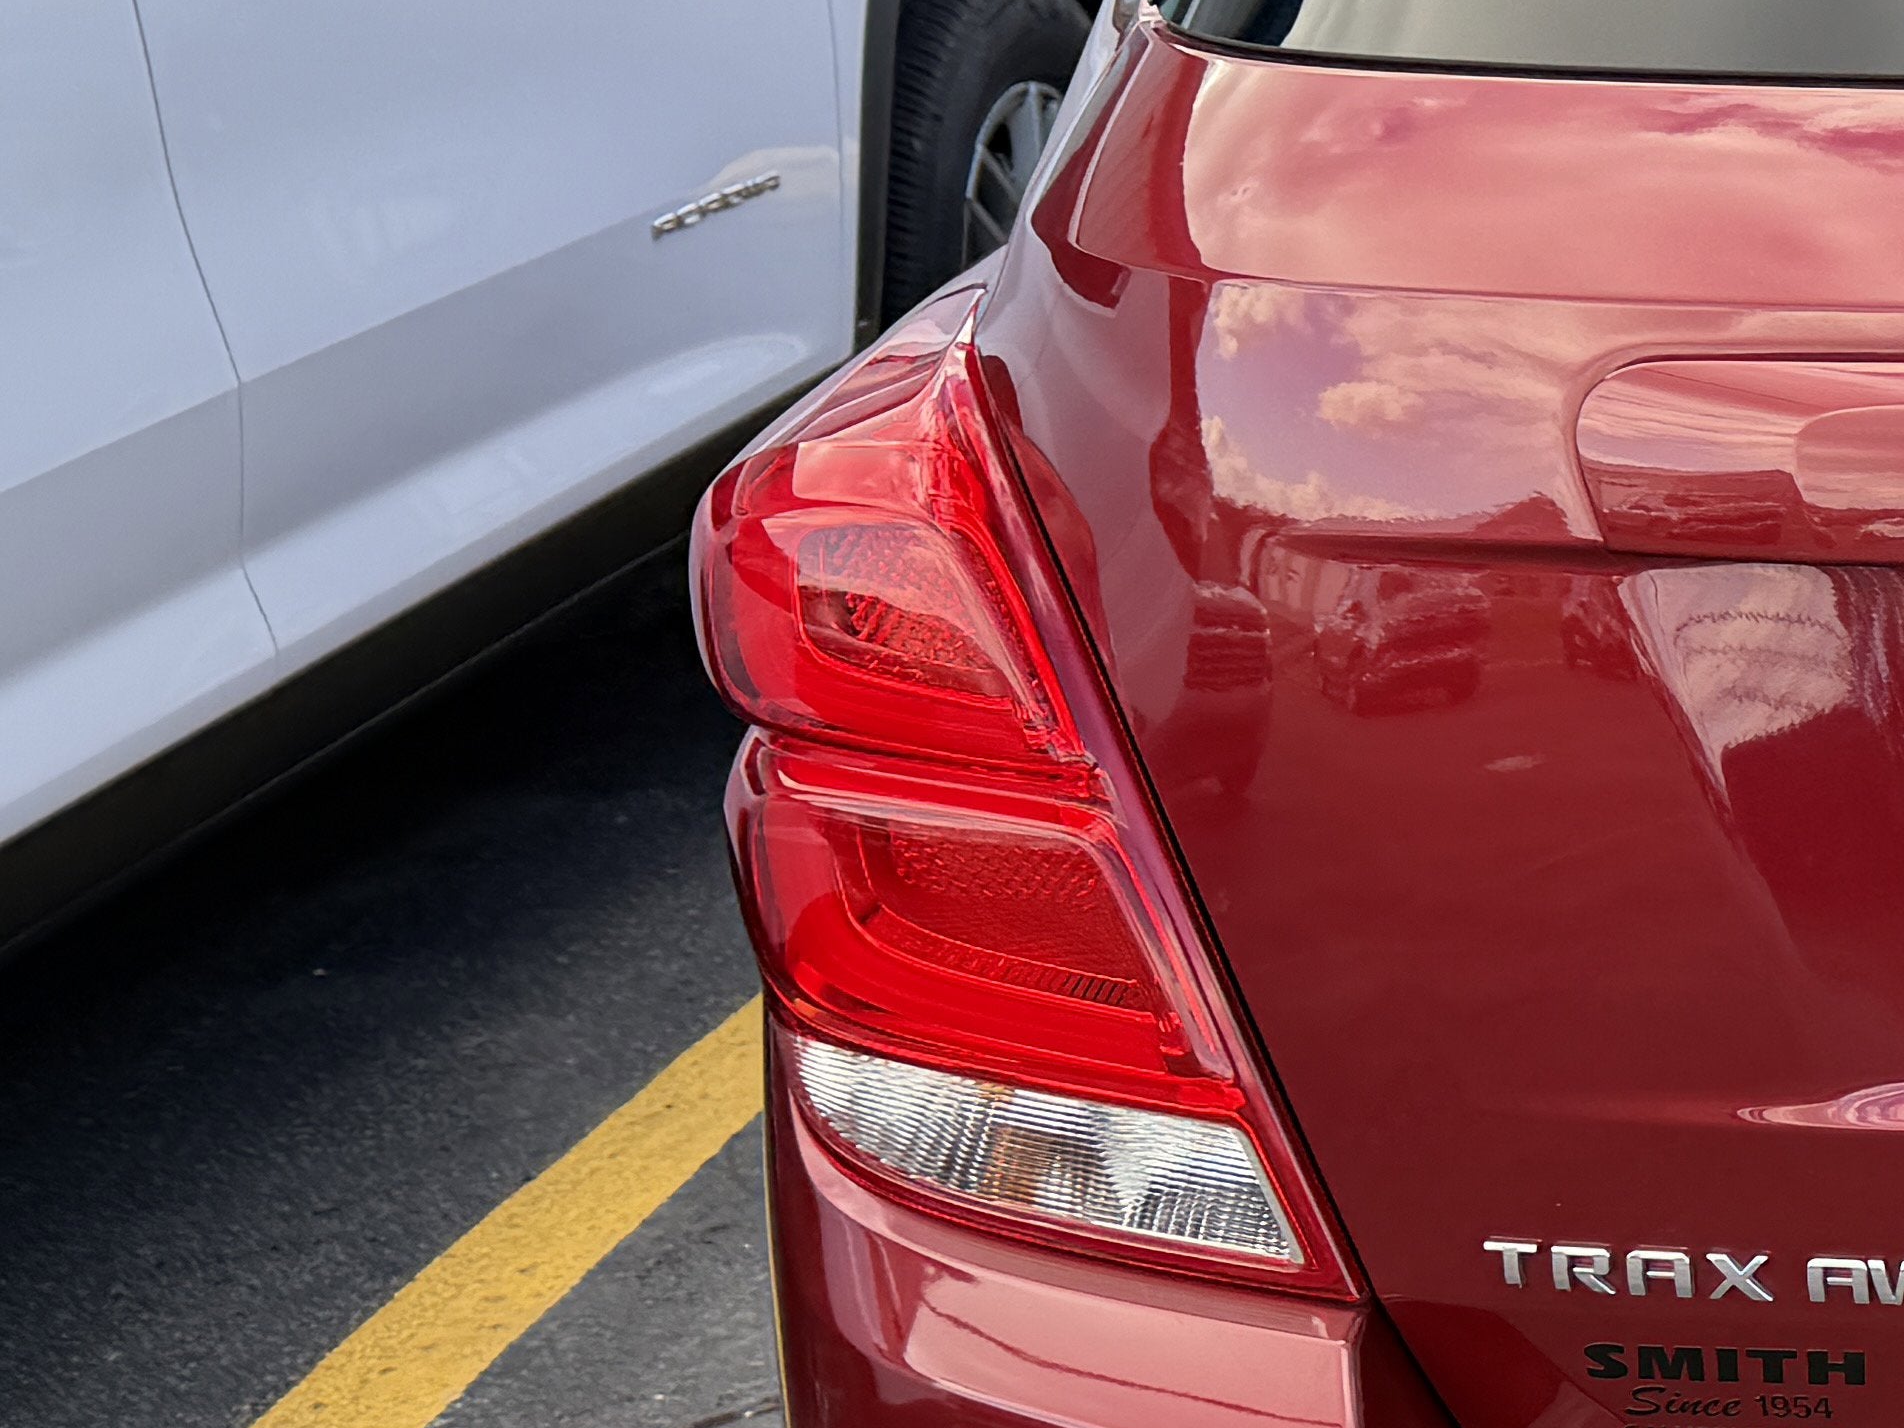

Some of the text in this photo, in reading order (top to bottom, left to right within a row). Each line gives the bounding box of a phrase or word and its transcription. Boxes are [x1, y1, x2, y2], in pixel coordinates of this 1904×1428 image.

[1482, 1240, 1774, 1302] TRAX
[1583, 1342, 1867, 1386] SMITH
[1624, 1385, 1834, 1419] Since 1954
